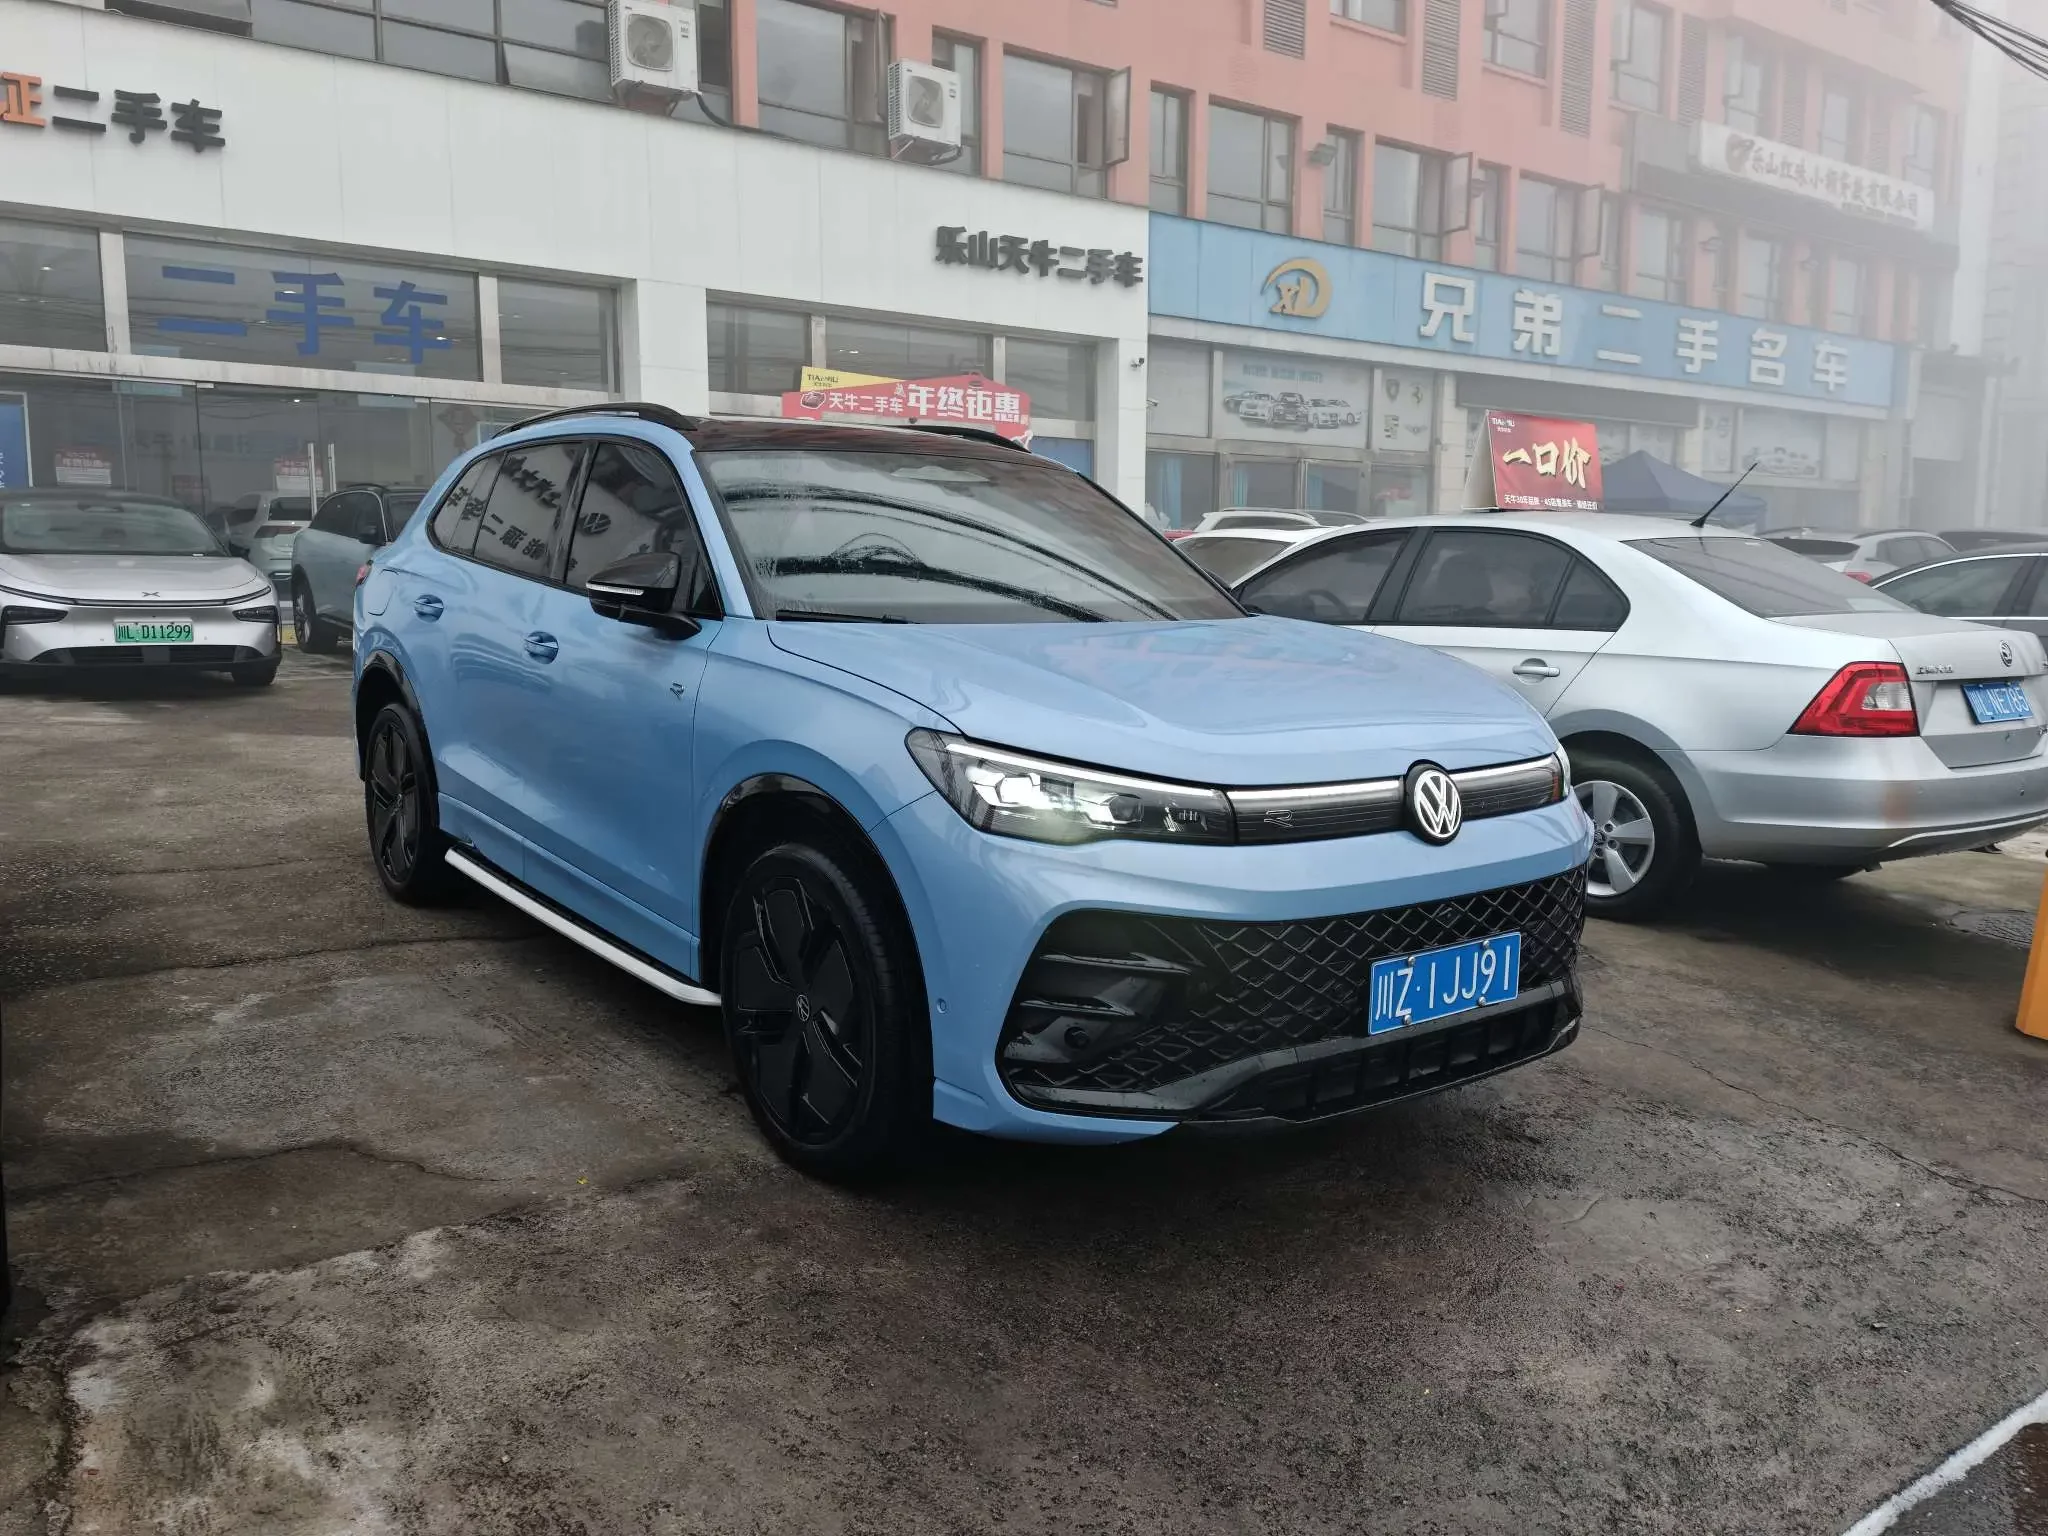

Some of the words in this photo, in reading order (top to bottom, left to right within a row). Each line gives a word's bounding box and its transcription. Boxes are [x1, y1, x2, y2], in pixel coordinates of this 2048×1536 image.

[935, 226, 1143, 287] 乐山天牛二手车
[157, 265, 450, 364] 二手车
[1420, 271, 1850, 392] 兄弟二手名车
[829, 391, 904, 413] 天牛二手车
[908, 384, 1020, 423] 年终钜惠
[1503, 437, 1591, 489] 一口价
